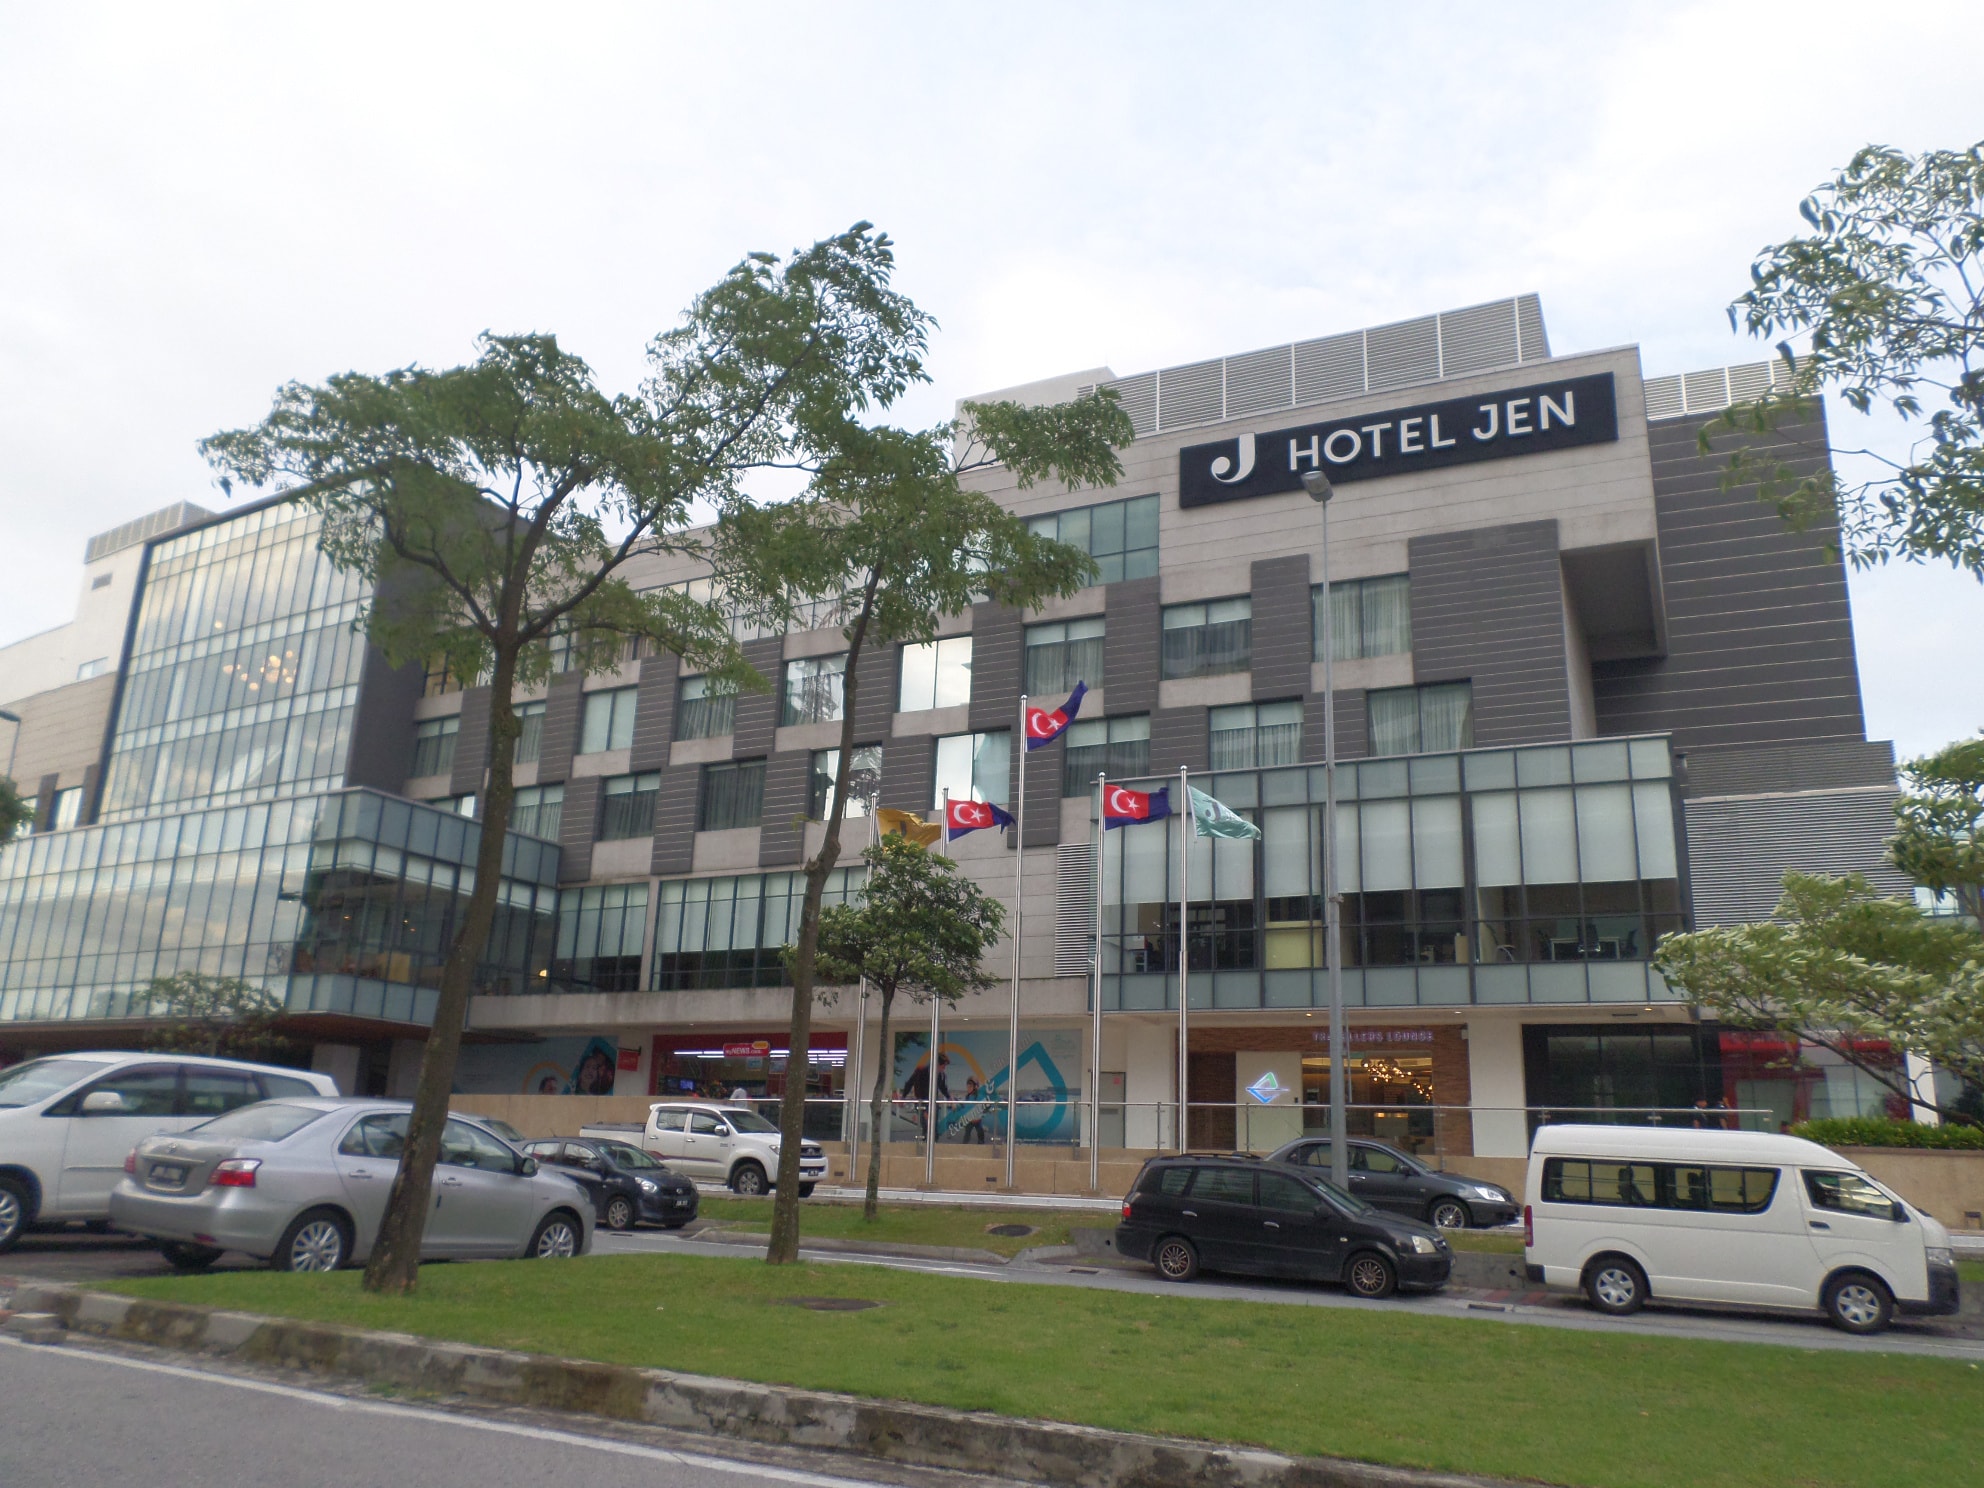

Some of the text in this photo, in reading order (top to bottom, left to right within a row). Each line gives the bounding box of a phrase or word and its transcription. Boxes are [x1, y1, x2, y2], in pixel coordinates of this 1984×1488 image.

[1289, 390, 1575, 472] HOTEL JEN
[1210, 432, 1256, 483] J
[1312, 1031, 1434, 1042] TRLLERS LOUNGE
